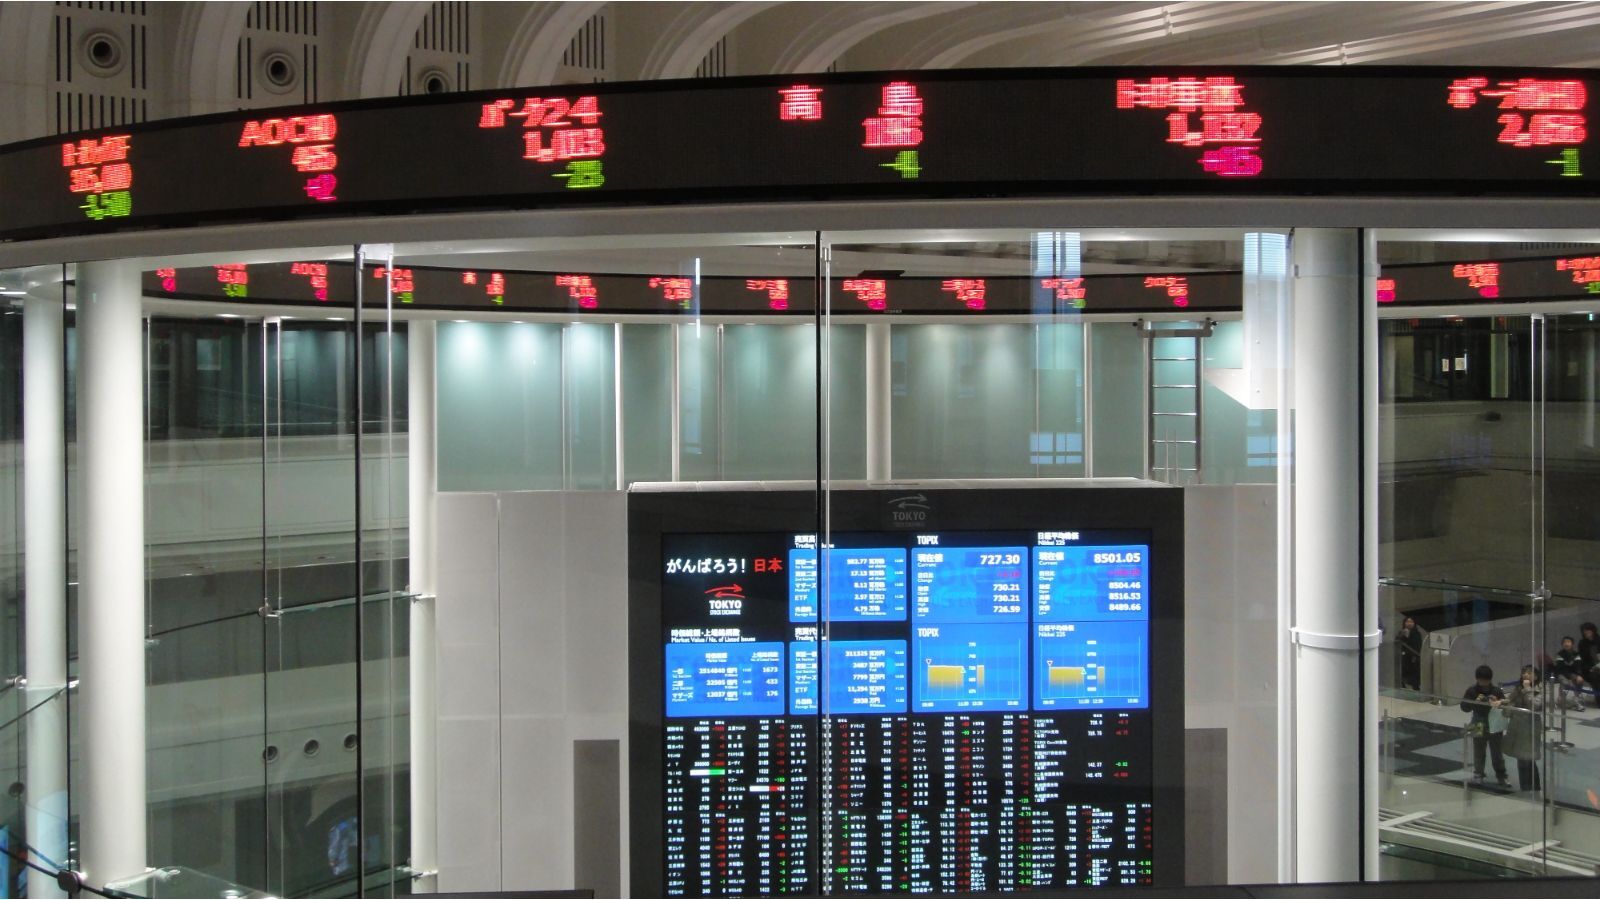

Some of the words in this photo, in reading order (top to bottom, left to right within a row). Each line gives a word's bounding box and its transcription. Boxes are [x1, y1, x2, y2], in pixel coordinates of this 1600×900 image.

[893, 512, 925, 521] TOKYO
[917, 535, 939, 545] TOPIX
[980, 554, 1020, 565] 727.30
[1094, 553, 1141, 563] 8501.05
[754, 558, 783, 572] 日本
[709, 600, 742, 609] TOKYO
[918, 628, 939, 637] TOPIX
